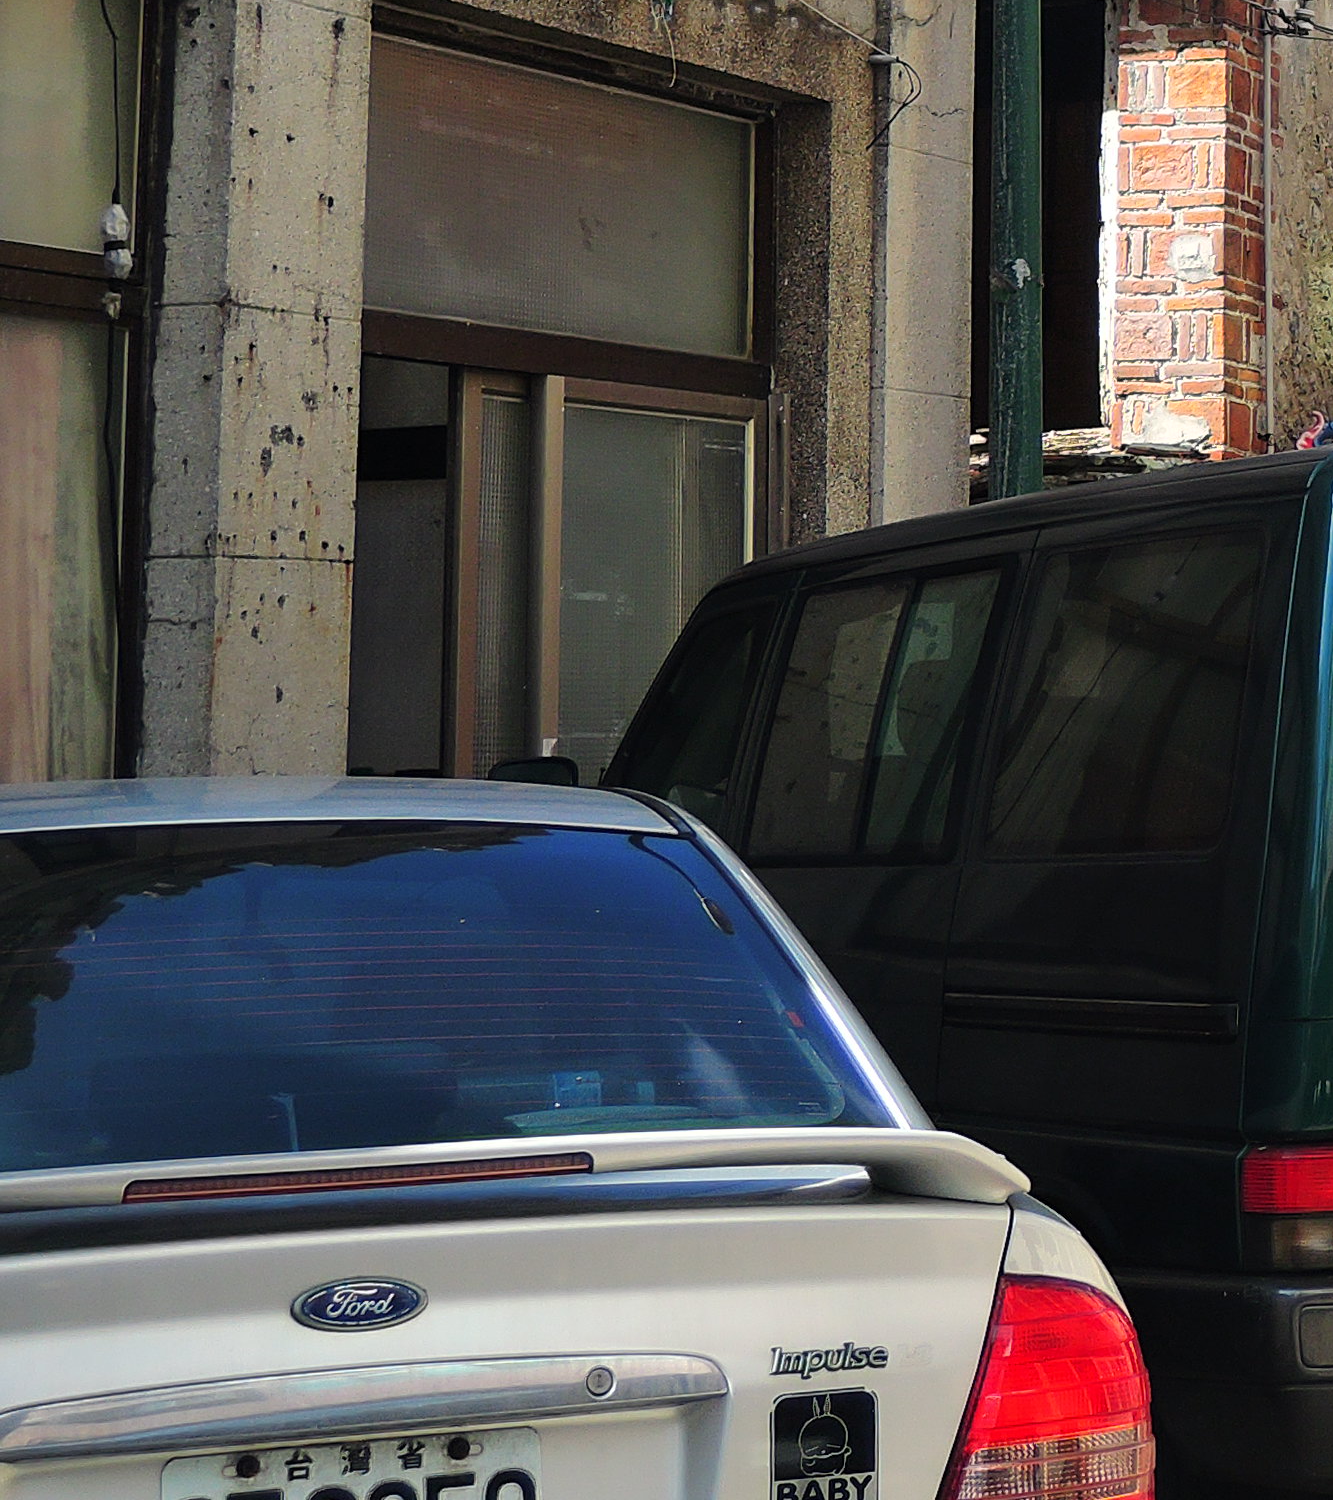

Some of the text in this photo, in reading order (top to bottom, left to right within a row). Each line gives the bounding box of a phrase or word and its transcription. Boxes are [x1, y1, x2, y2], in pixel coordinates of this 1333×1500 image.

[326, 1288, 395, 1318] Ford
[769, 1341, 889, 1380] Impulse
[285, 1441, 426, 1482] 台灣省
